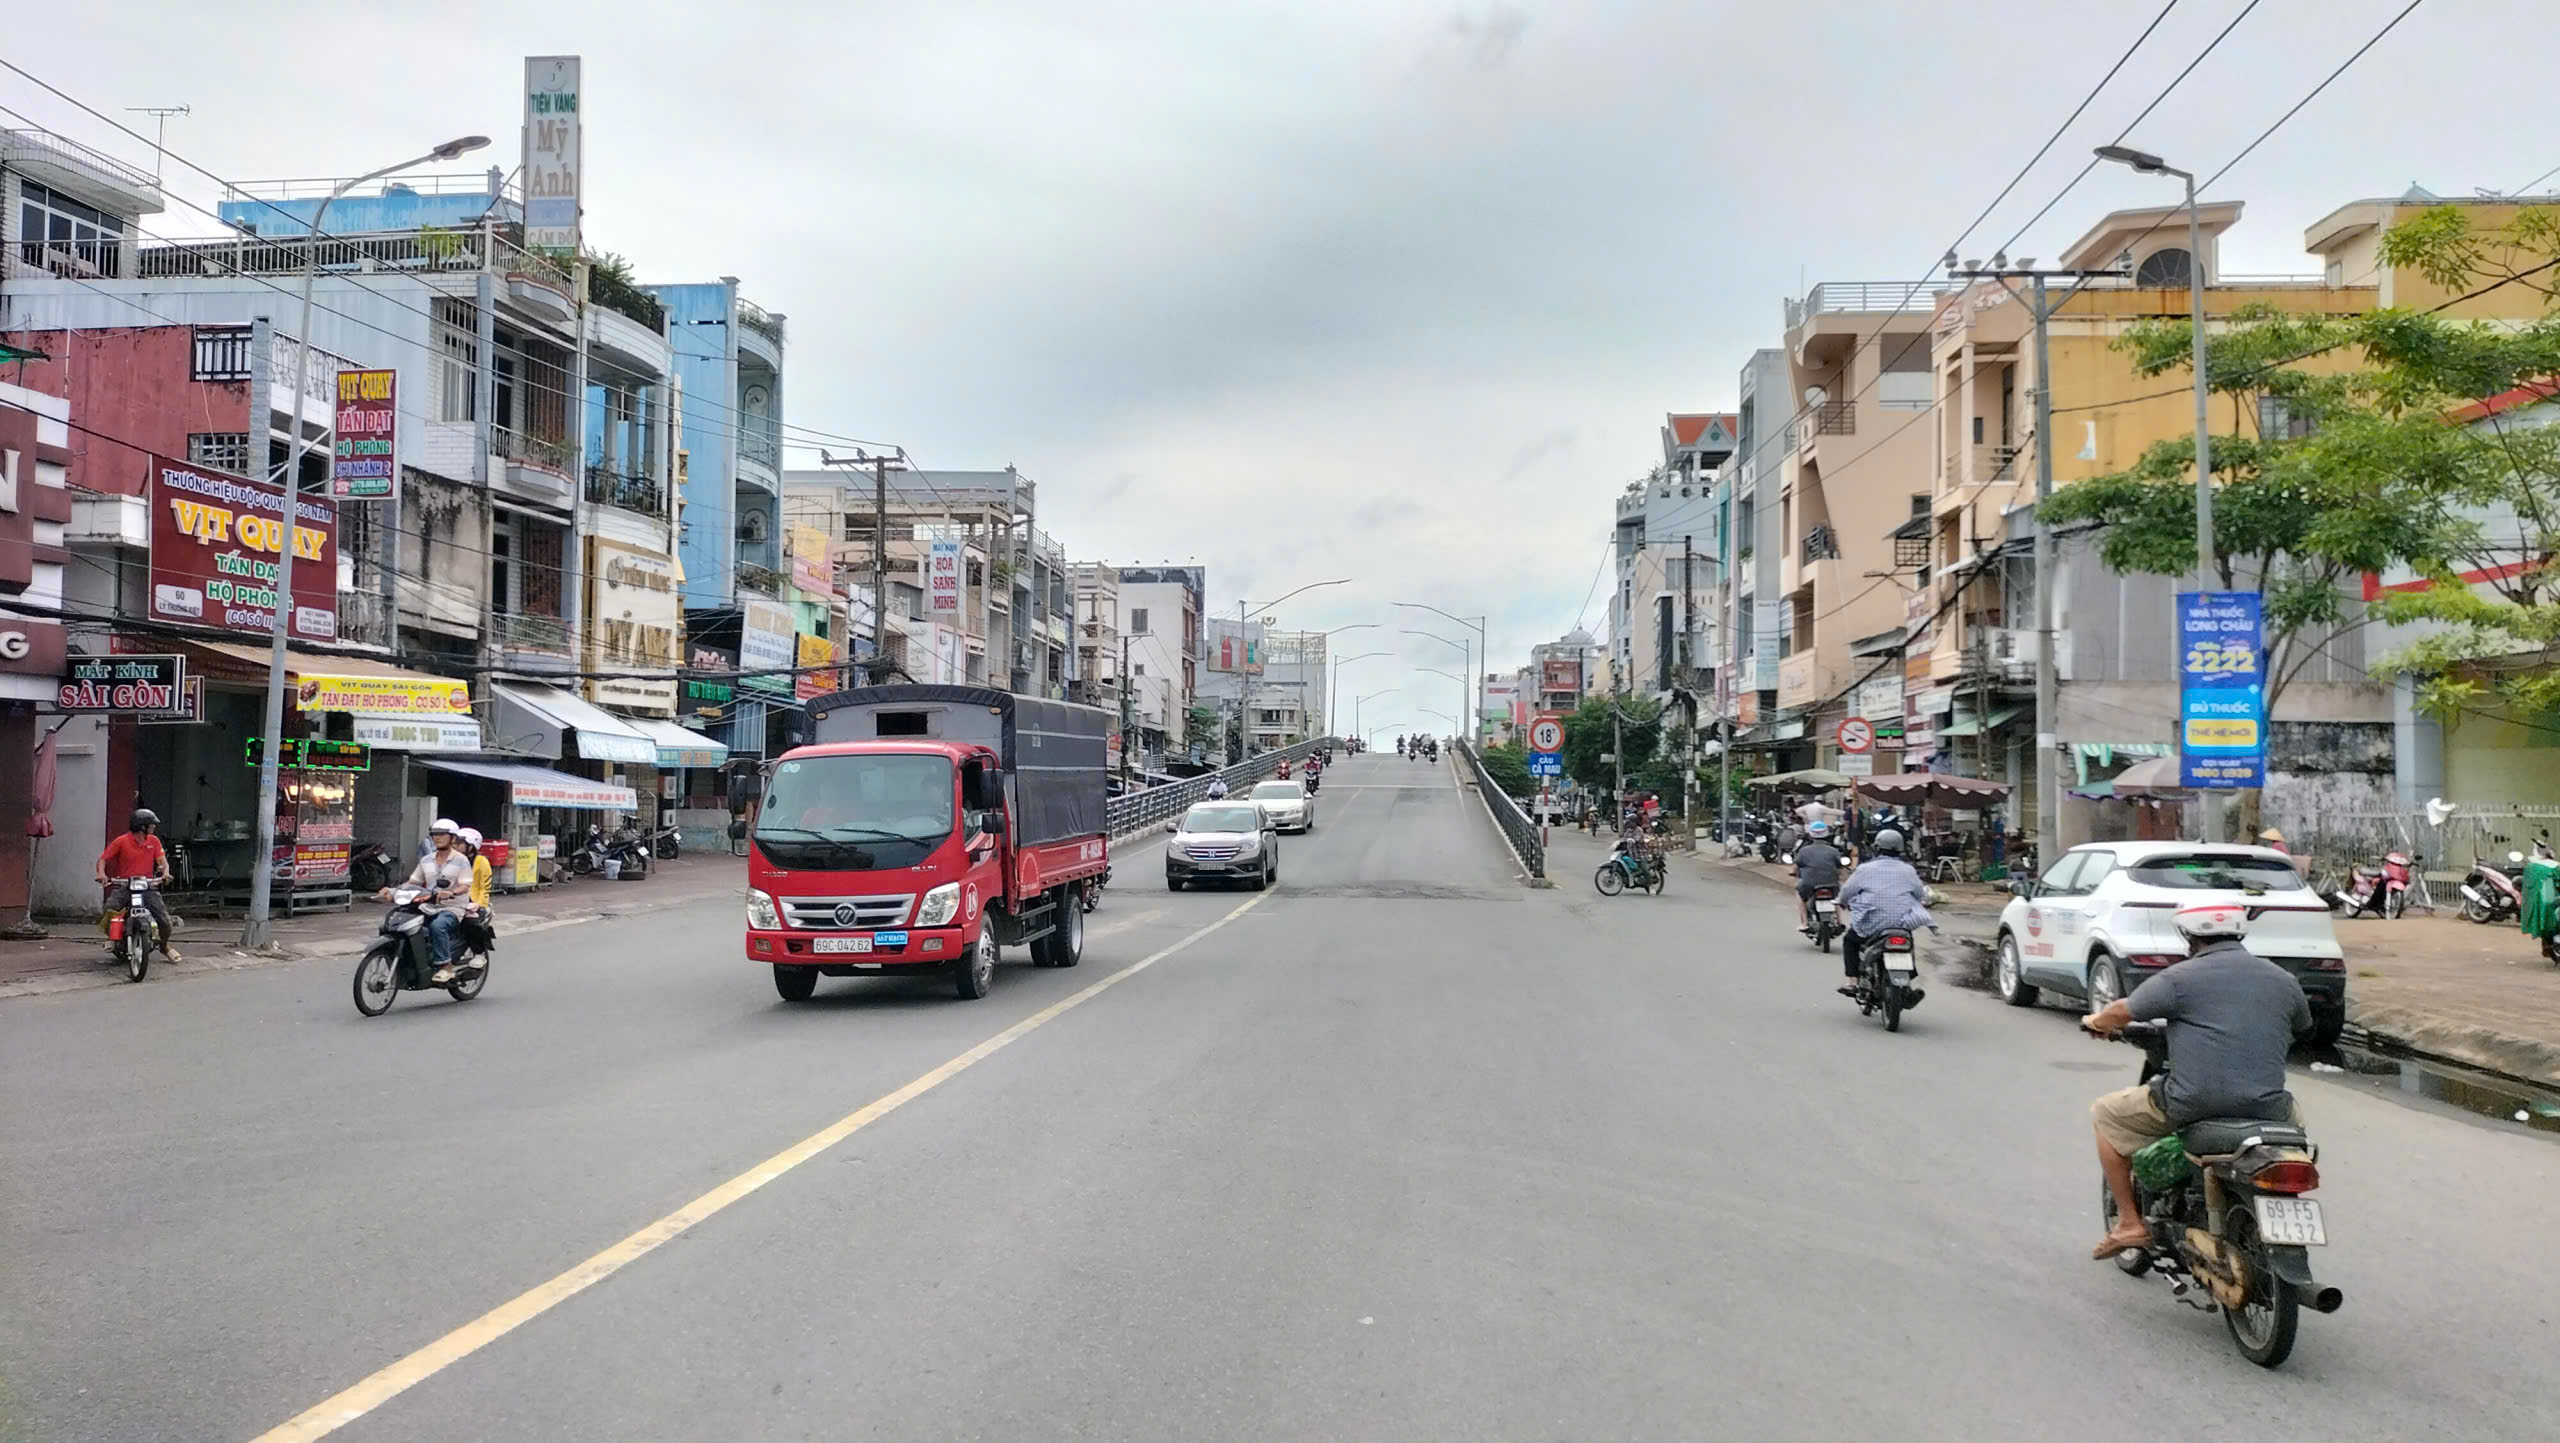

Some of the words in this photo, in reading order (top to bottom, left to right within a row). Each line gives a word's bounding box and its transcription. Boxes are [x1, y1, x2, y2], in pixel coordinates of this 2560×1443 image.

[530, 163, 575, 197] Anh
[338, 373, 360, 405] VỊT
[360, 371, 393, 401] QUAY
[337, 405, 365, 432] TẤN
[366, 410, 393, 436] ĐẠT
[336, 437, 353, 458] HỘ
[354, 436, 393, 455] PHÒNG
[383, 461, 392, 476] 2
[211, 480, 239, 504] HIỆU
[240, 486, 261, 509] ĐỘC
[170, 498, 233, 546] VỊT
[235, 514, 328, 562] QUAY
[214, 550, 251, 575] TẤN
[933, 576, 956, 590] SANH
[174, 589, 186, 601] 60
[206, 580, 233, 608] HỘ
[933, 595, 956, 610] MINH
[2210, 605, 2246, 618] THUỐC
[2184, 620, 2219, 632] LONG
[2219, 619, 2254, 632] CHÂU
[75, 659, 112, 680] MẮT
[115, 662, 159, 679] KÍNH
[2184, 650, 2256, 673] 2222
[59, 680, 110, 709] SÀI
[112, 679, 173, 709] GÒN
[442, 697, 448, 710] 2
[2209, 700, 2251, 713] THUỐC
[1531, 763, 1543, 774] CÀ
[1543, 764, 1561, 774] MAU
